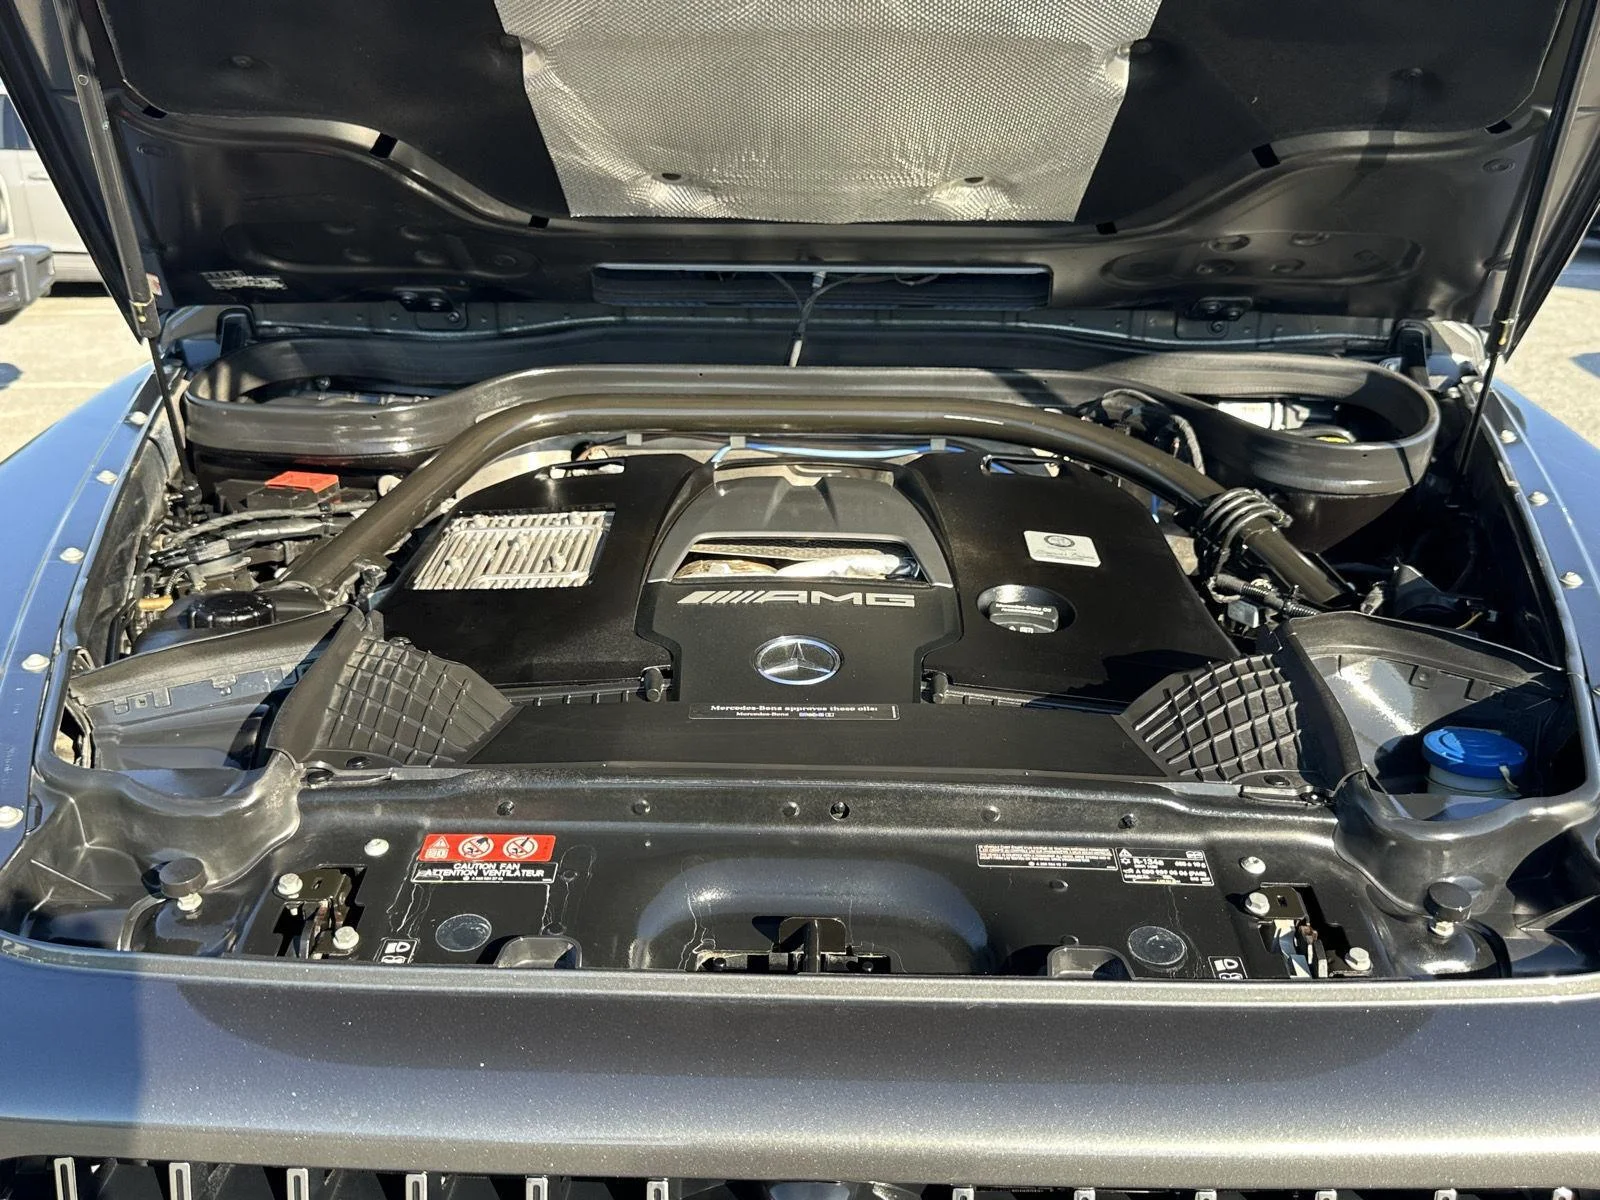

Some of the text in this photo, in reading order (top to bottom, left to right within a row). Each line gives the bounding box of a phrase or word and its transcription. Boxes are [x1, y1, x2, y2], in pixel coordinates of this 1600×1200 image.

[752, 590, 915, 607] AMG
[426, 869, 545, 877] ATTENTION VENTILATEUR
